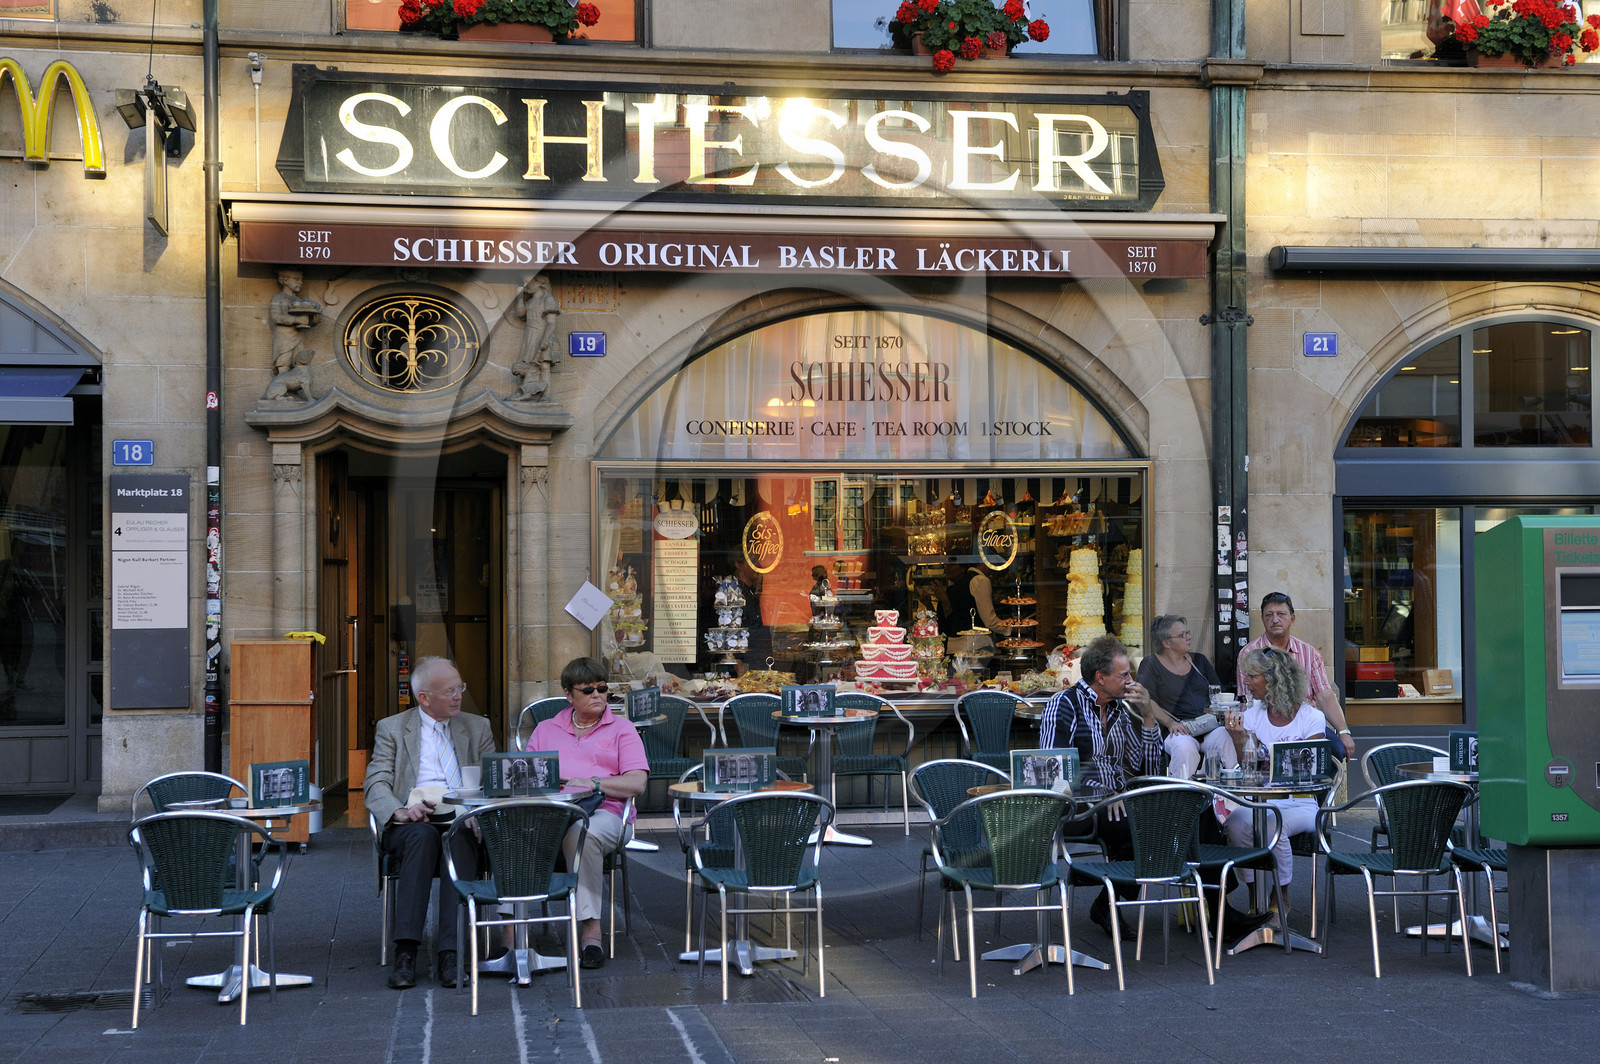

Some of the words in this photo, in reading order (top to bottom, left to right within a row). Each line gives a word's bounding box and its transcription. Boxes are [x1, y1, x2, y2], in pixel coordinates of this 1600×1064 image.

[335, 91, 1113, 197] SCHIESSER
[298, 229, 332, 243] SEIT
[298, 245, 332, 260] 1870
[392, 236, 579, 266] SCHIESSER
[598, 241, 760, 270] ORIGINAL
[778, 244, 898, 272] BASLER
[916, 242, 1071, 273] LÄCKERLI
[1127, 246, 1158, 258] SEIT
[1128, 261, 1157, 274] 1870
[579, 336, 596, 352] 19
[833, 335, 870, 349] SEIT
[874, 335, 904, 349] 1870
[1312, 337, 1329, 352] 21
[790, 361, 951, 403] SCHIESSER
[686, 420, 795, 437] CONFISERIE
[810, 420, 857, 437] CAFE
[871, 420, 910, 437] TEA
[913, 420, 968, 437] ROOM
[980, 421, 1053, 437] 1.STOCK
[122, 444, 143, 461] 18
[117, 488, 168, 498] Marktplatz
[170, 488, 183, 497] 18
[657, 519, 694, 529] SCHIESSER
[751, 523, 777, 541] Eis-
[980, 527, 1014, 549] Glaces
[1554, 532, 1599, 546] Billette
[748, 539, 780, 561] Kaffee
[1551, 813, 1568, 822] 1357
